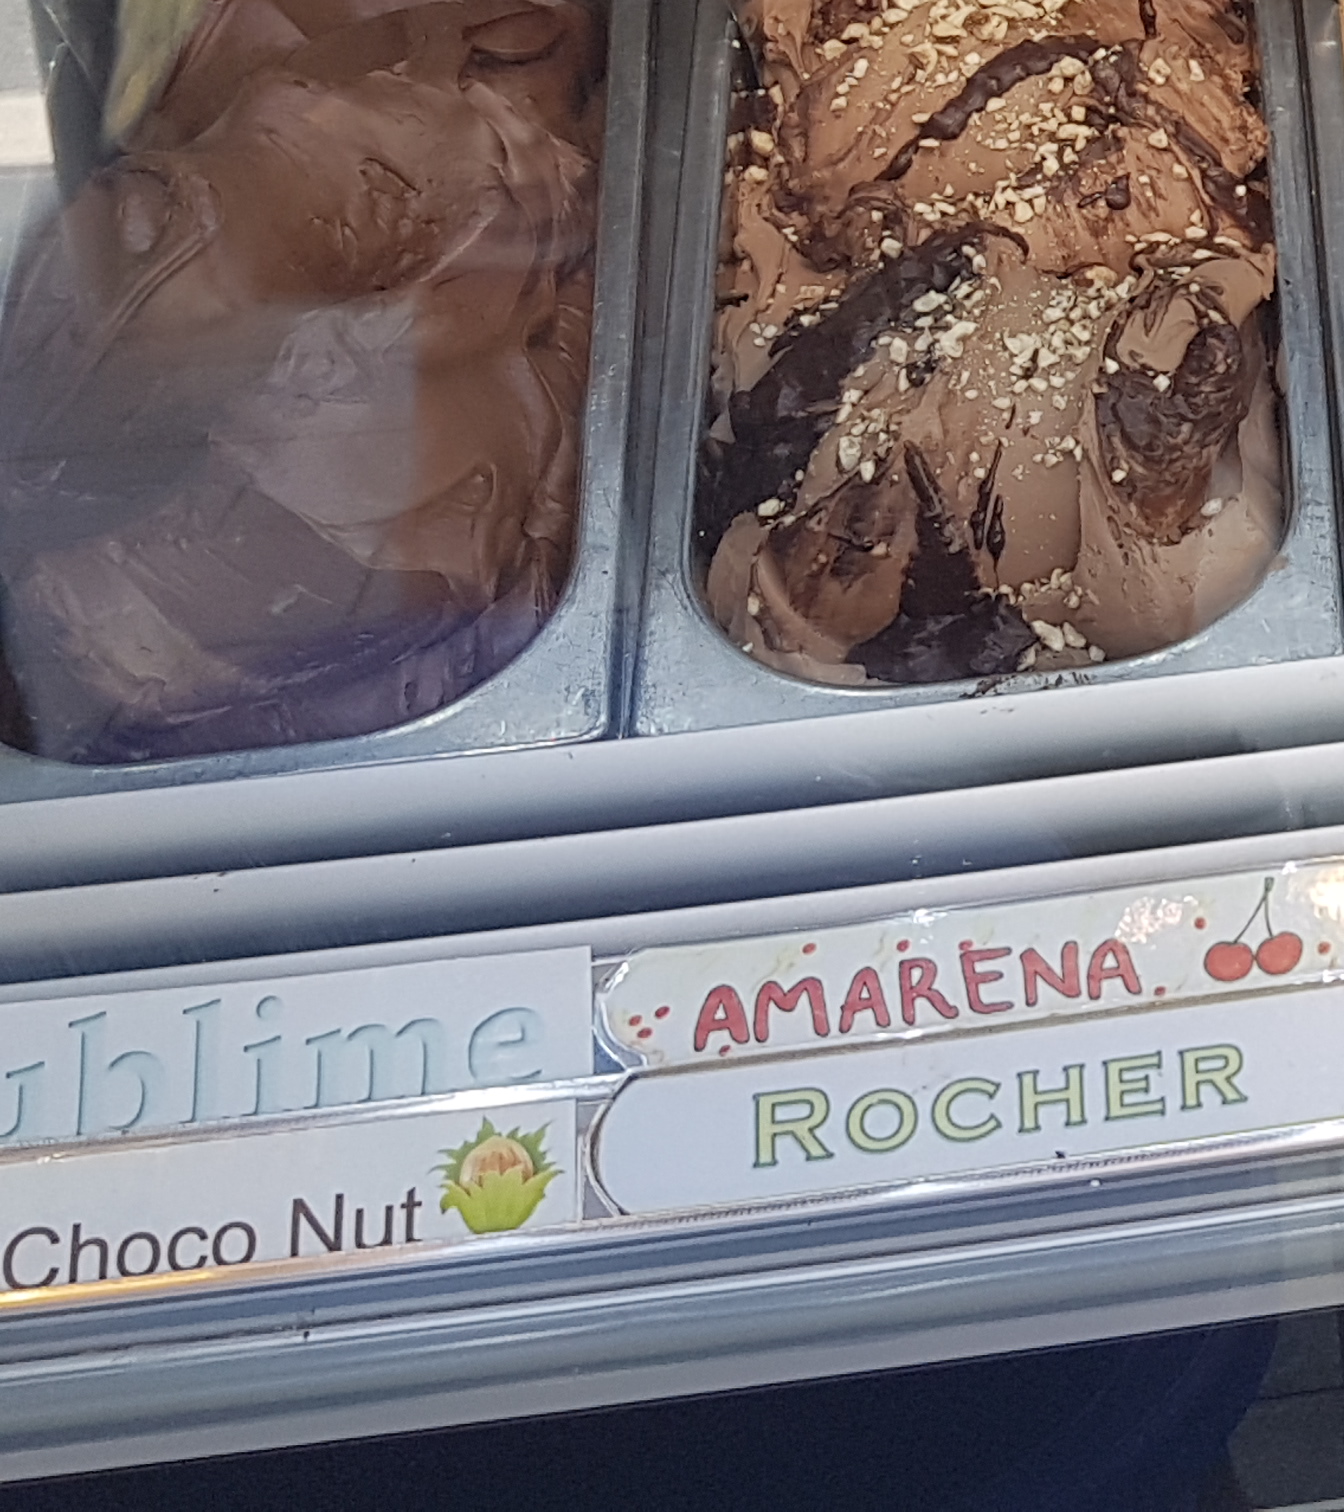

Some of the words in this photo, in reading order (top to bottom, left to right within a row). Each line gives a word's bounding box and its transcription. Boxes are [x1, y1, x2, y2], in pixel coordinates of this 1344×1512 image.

[693, 937, 1144, 1053] AMARENA
[752, 1042, 1249, 1169] ROCHER
[2, 1218, 258, 1291] Choco
[290, 1187, 424, 1259] Nut
